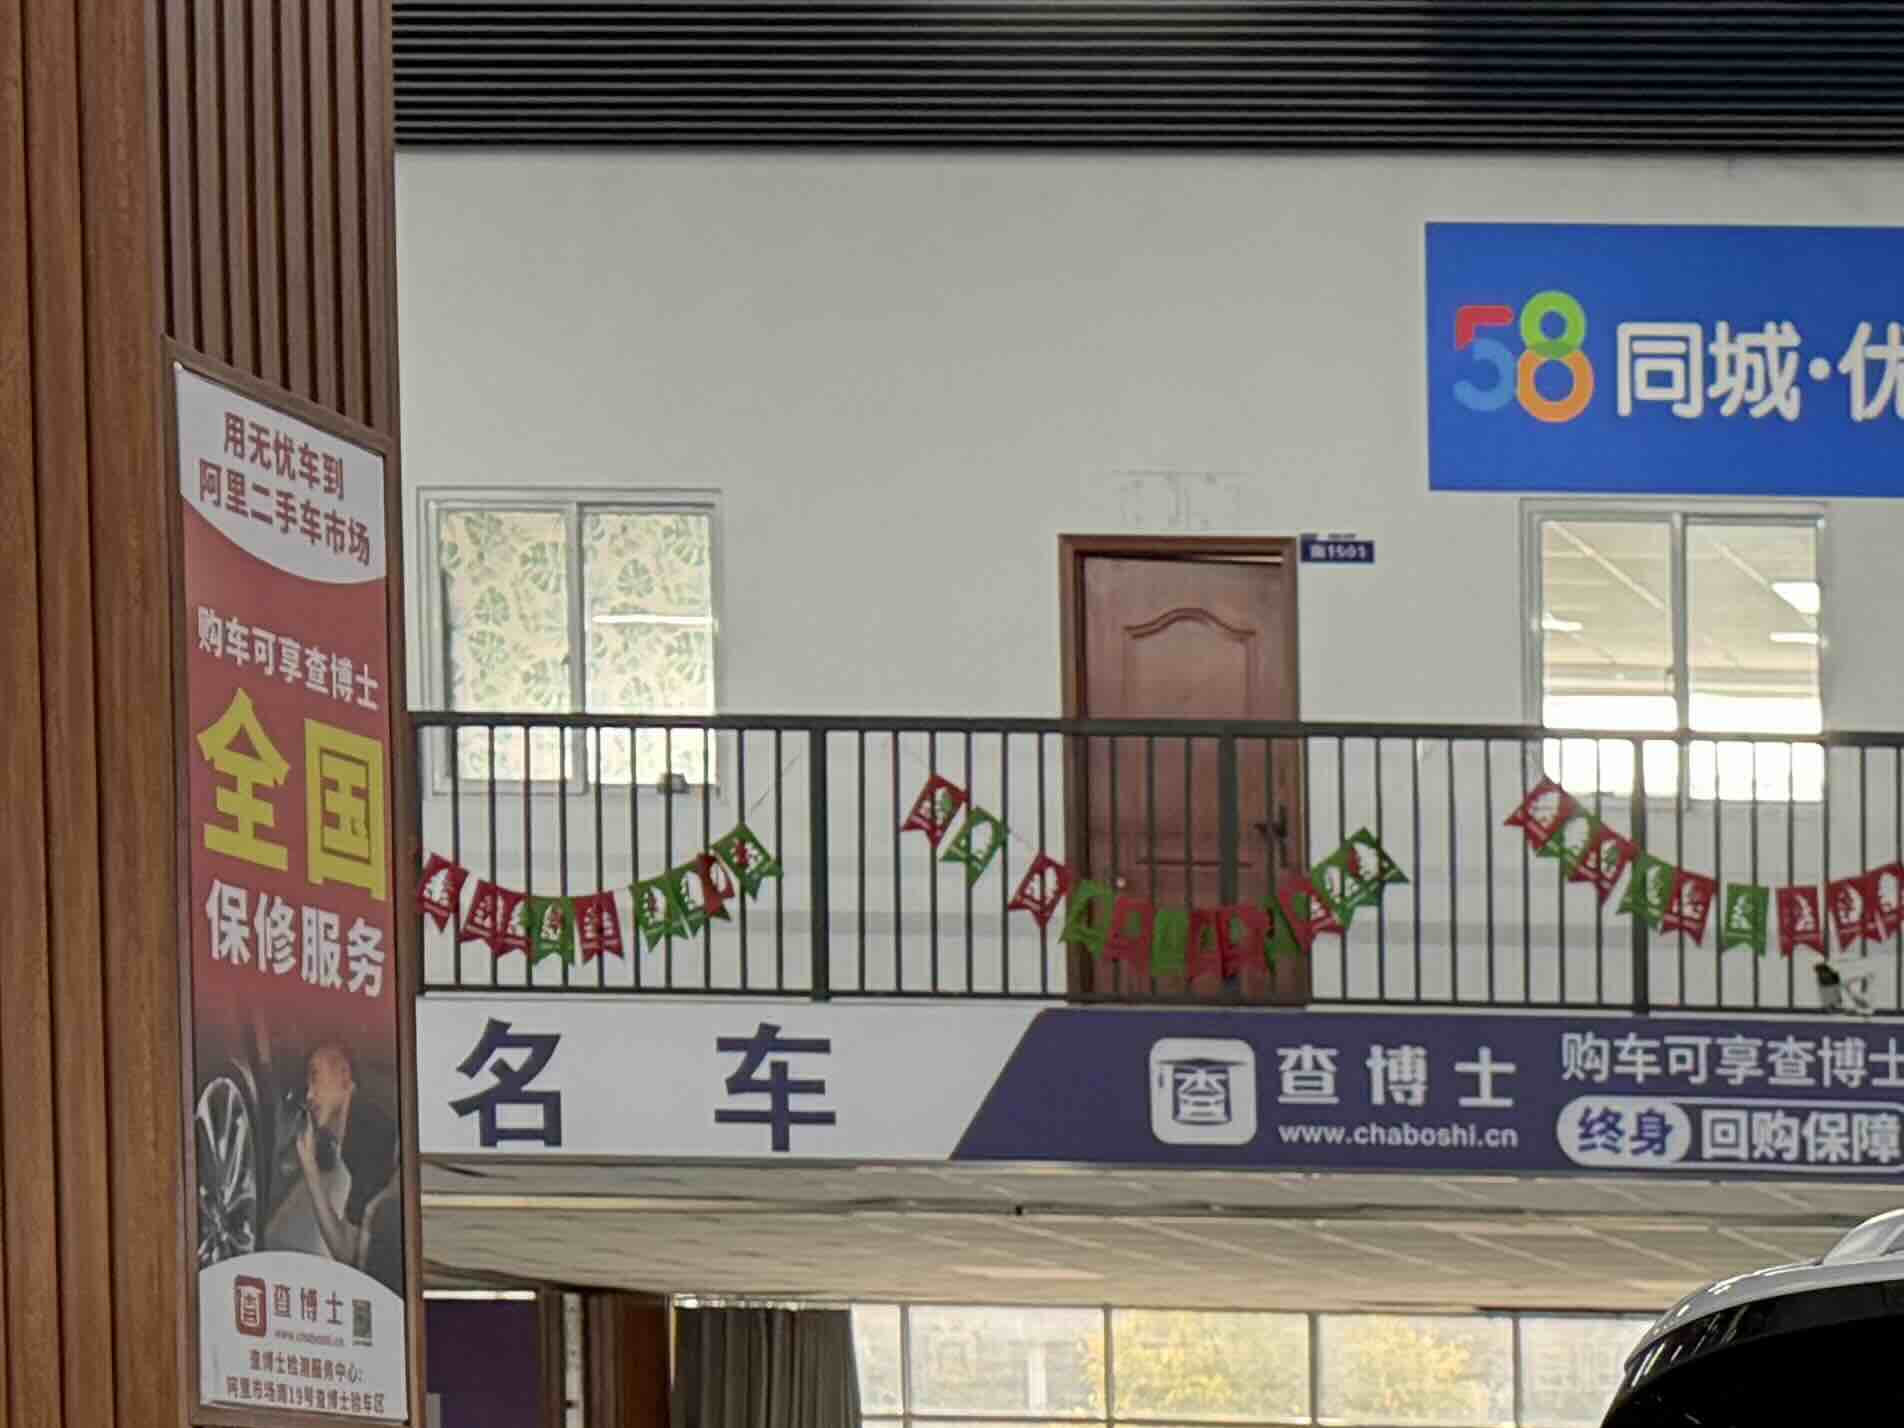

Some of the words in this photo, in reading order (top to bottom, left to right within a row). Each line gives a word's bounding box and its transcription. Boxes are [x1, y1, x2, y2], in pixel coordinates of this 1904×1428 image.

[199, 461, 372, 567] 阿里二手车市场
[197, 605, 381, 713] 购车可享查博士
[196, 687, 388, 902] 全国
[205, 879, 387, 999] 保修服务
[448, 1016, 837, 1153] 名车
[1276, 1043, 1517, 1108] 查博士
[1277, 1122, 1520, 1148] www.chaboshi.cn
